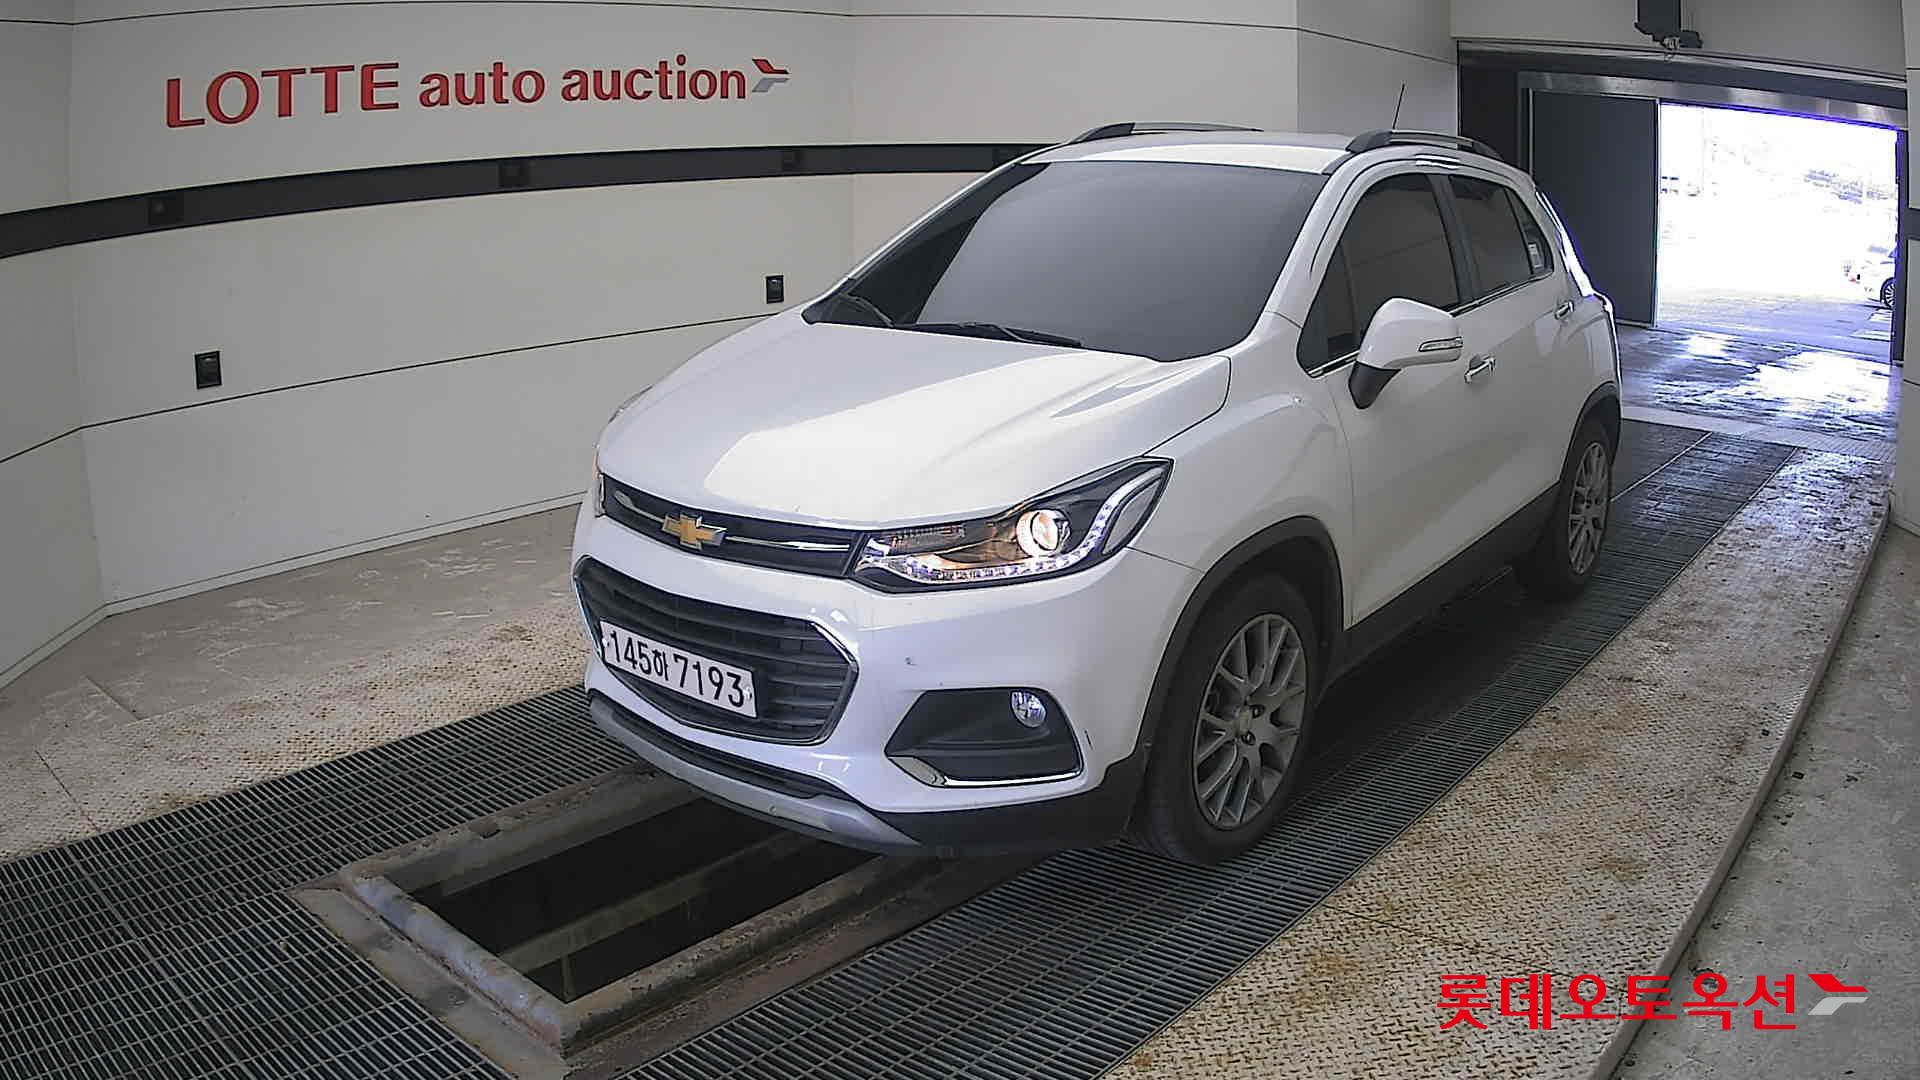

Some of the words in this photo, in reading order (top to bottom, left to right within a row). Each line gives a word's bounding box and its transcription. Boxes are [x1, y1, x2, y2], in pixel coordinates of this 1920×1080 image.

[166, 62, 399, 128] LOTTE
[419, 62, 545, 107] auto
[561, 54, 746, 101] auction
